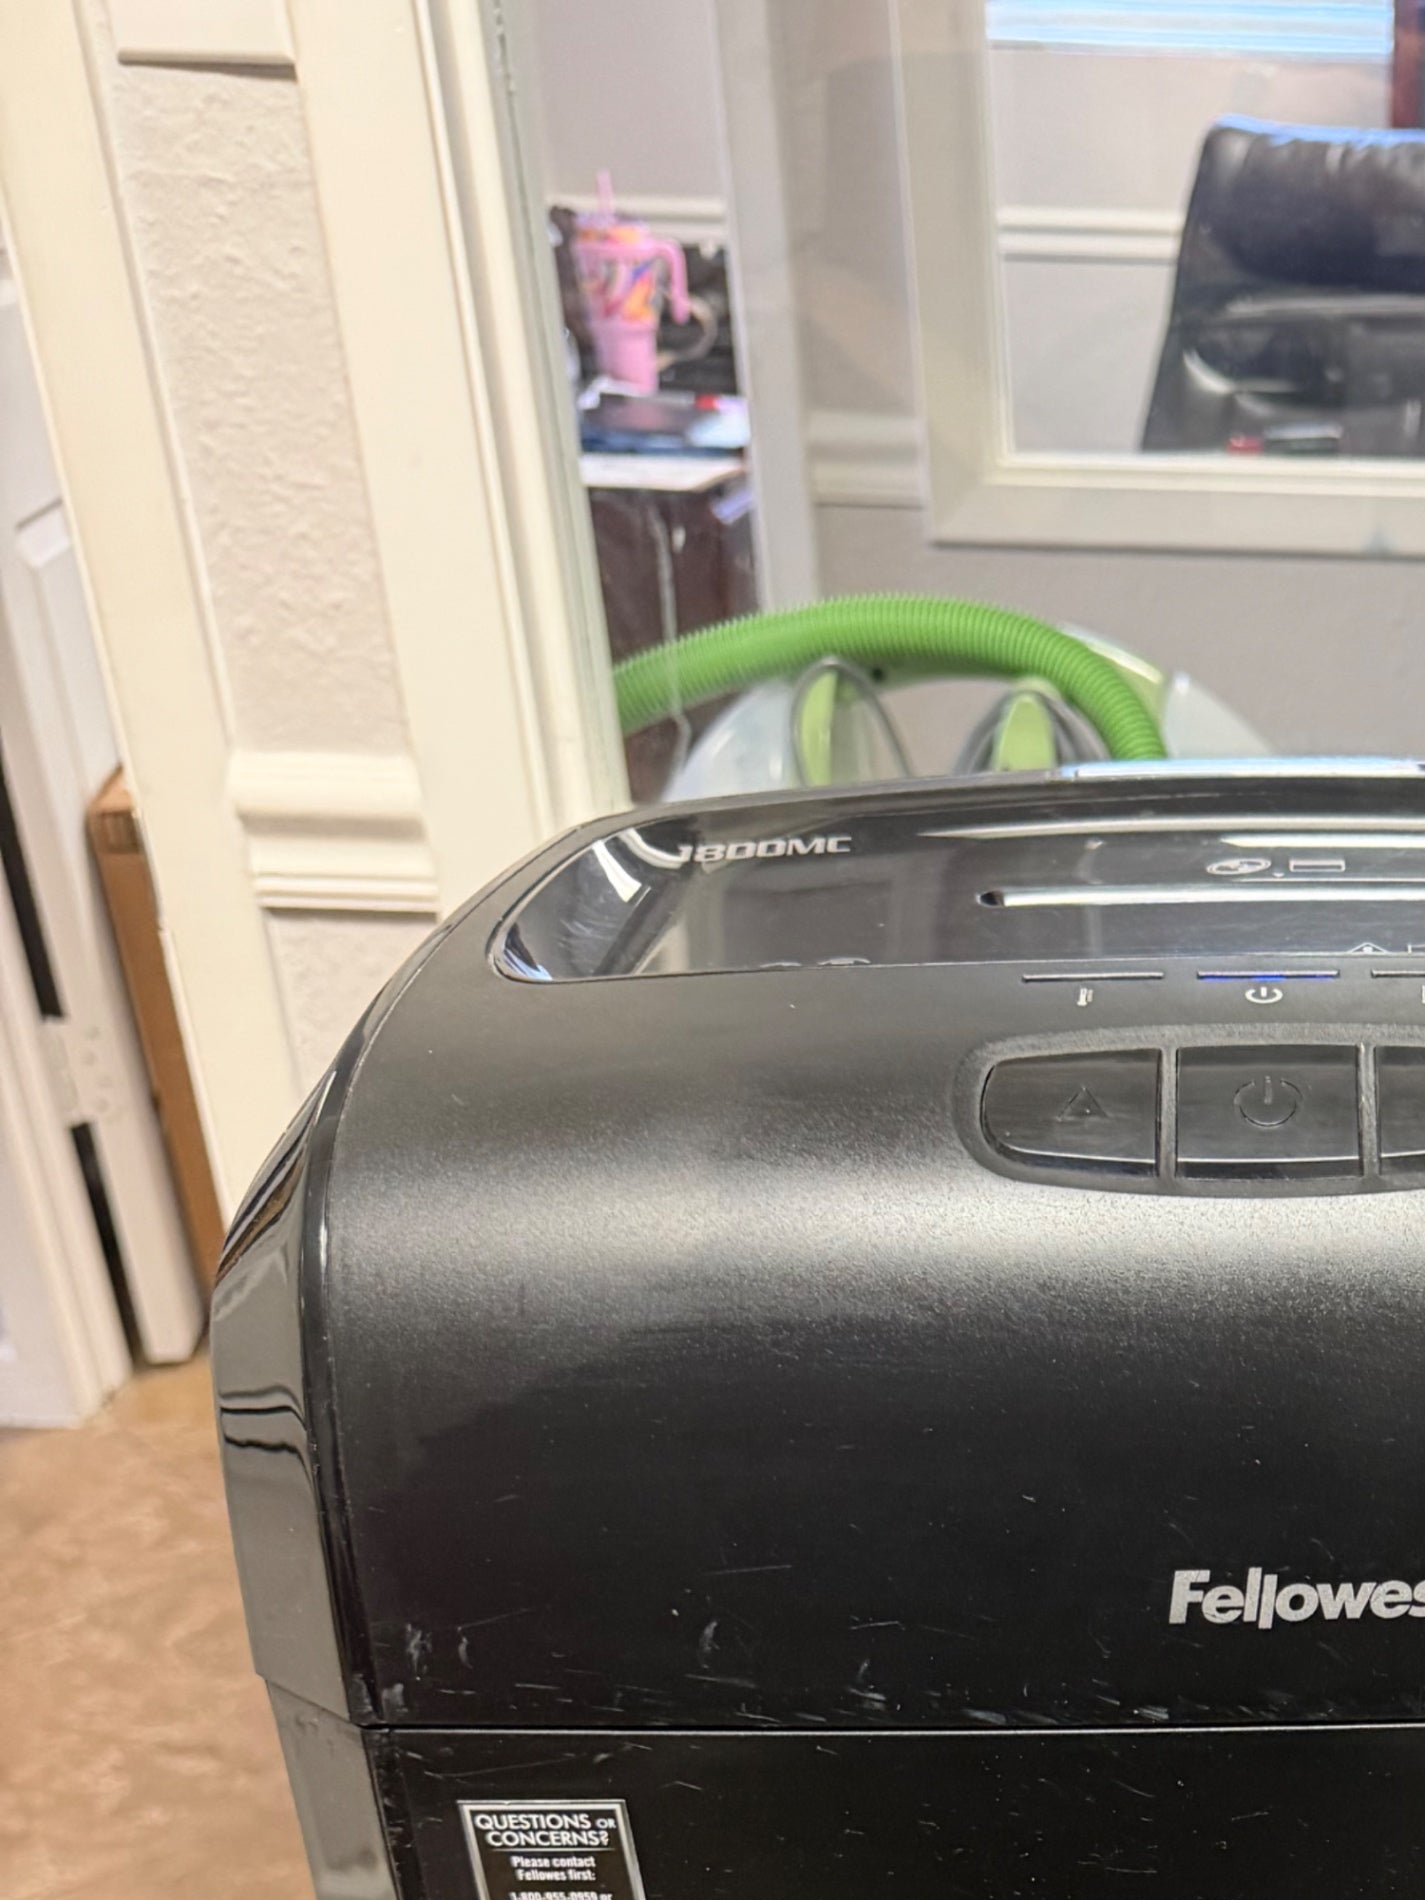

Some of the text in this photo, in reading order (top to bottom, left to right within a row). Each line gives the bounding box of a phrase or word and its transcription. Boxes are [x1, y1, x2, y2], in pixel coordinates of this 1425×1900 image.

[677, 836, 852, 862] 1800MC
[475, 1813, 616, 1830] QUESTIONS OR
[486, 1830, 609, 1847] CONCERNS?
[511, 1856, 596, 1868] Please contact
[516, 1869, 596, 1881] Fellowes first:
